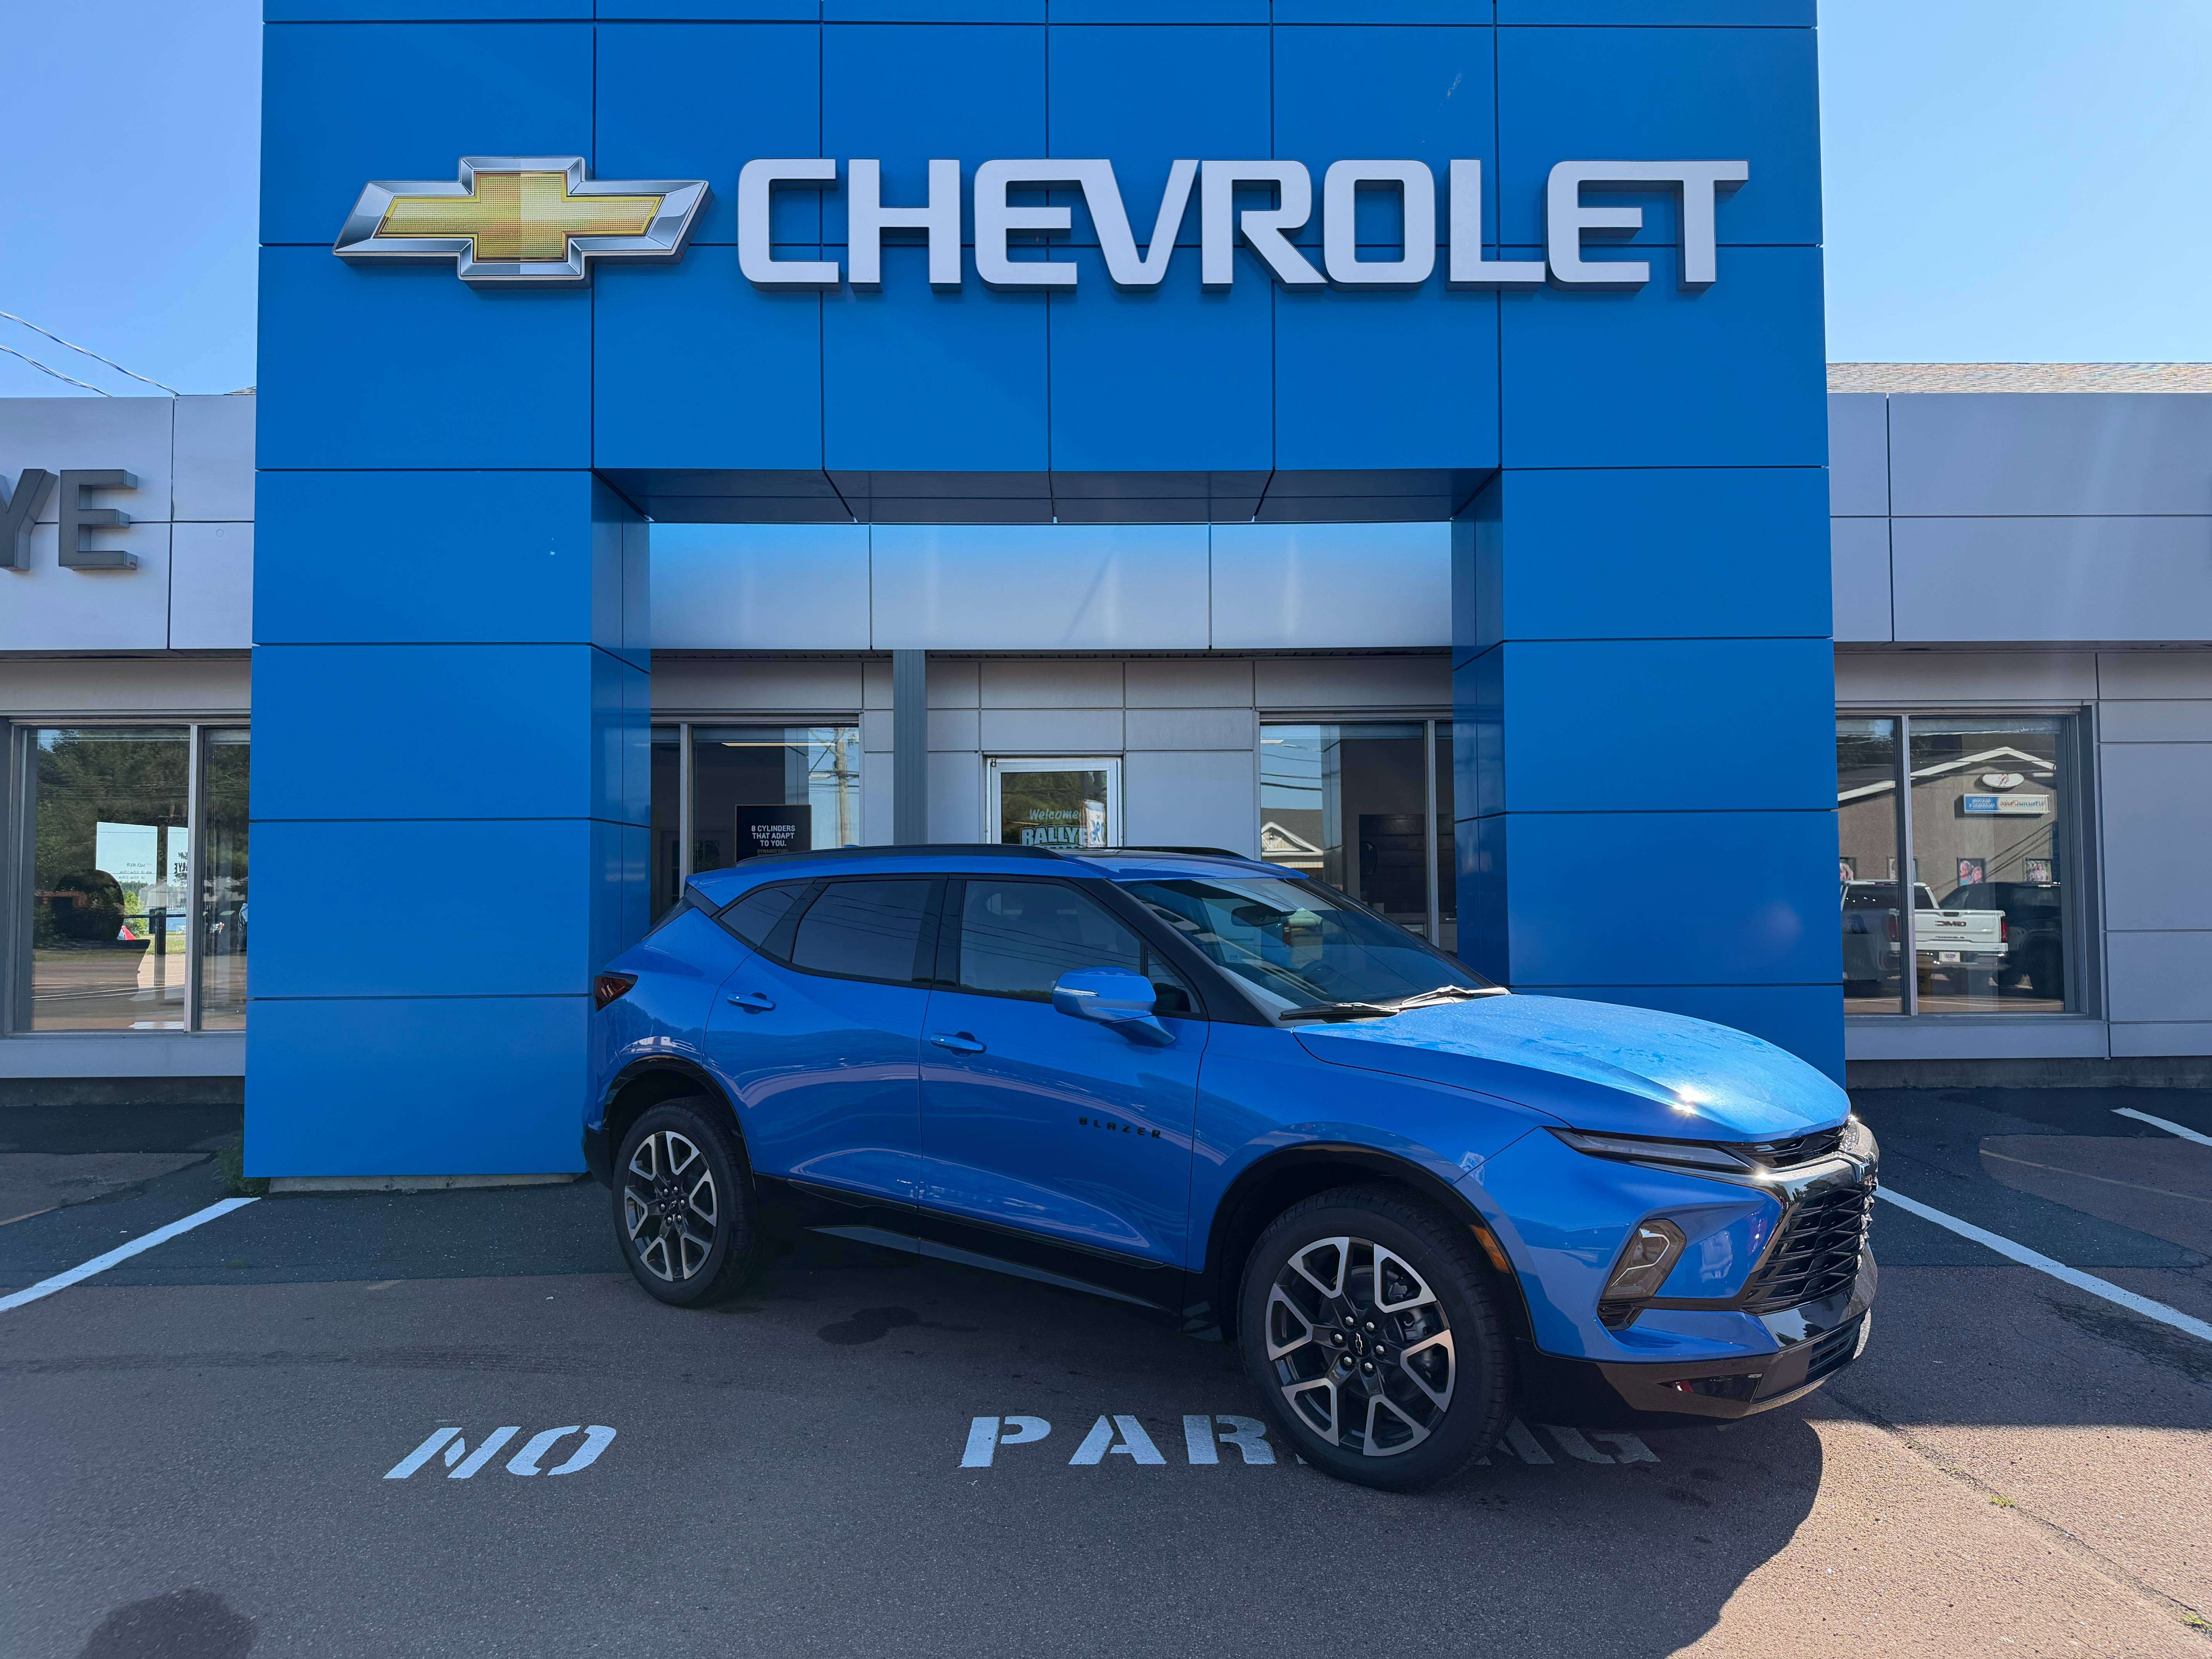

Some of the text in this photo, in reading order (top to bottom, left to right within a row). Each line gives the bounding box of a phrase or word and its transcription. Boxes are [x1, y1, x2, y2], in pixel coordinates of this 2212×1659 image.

[738, 158, 1748, 290] CHEVROLET
[1029, 809, 1079, 820] Welcome
[1021, 825, 1089, 847] RALLYE
[1079, 1117, 1161, 1139] BLAZER
[383, 1415, 1661, 1479] NO PARNG
